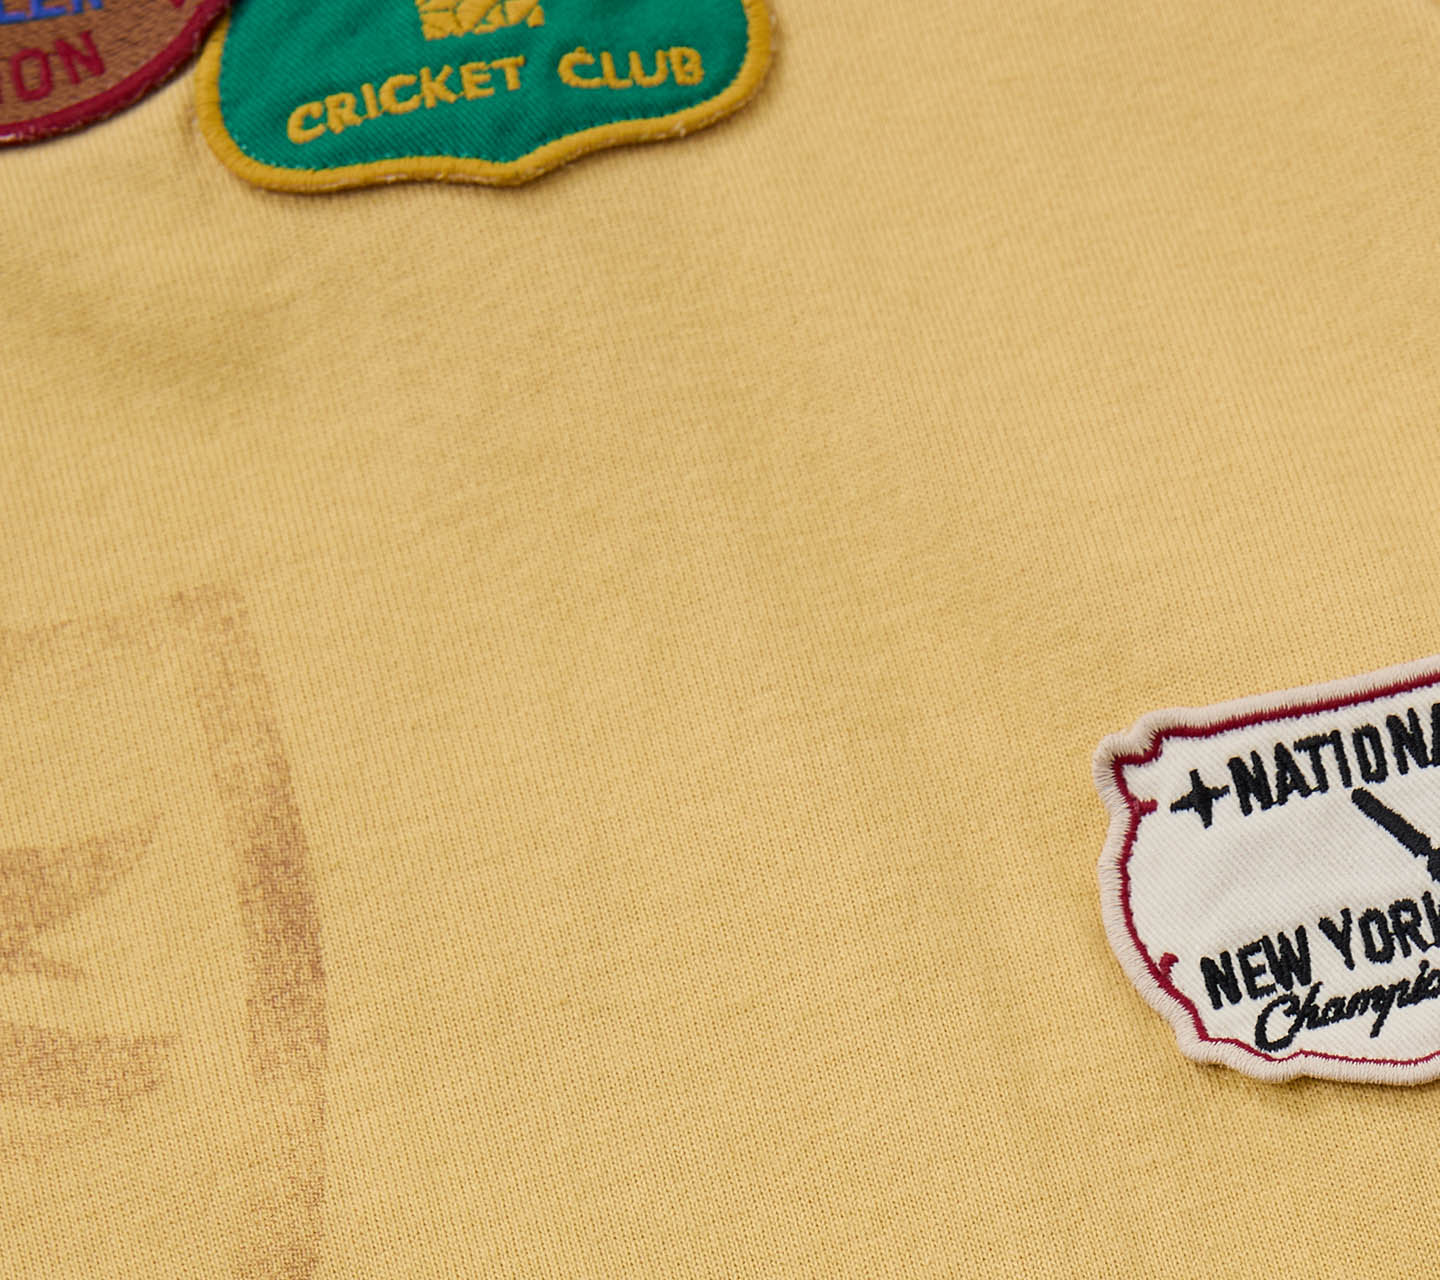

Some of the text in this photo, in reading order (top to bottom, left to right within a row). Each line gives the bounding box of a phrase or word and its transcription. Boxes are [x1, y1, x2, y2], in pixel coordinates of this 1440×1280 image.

[0, 30, 105, 101] ON
[287, 46, 704, 144] CRICKET CLUB
[1200, 925, 1312, 1010] NEW
